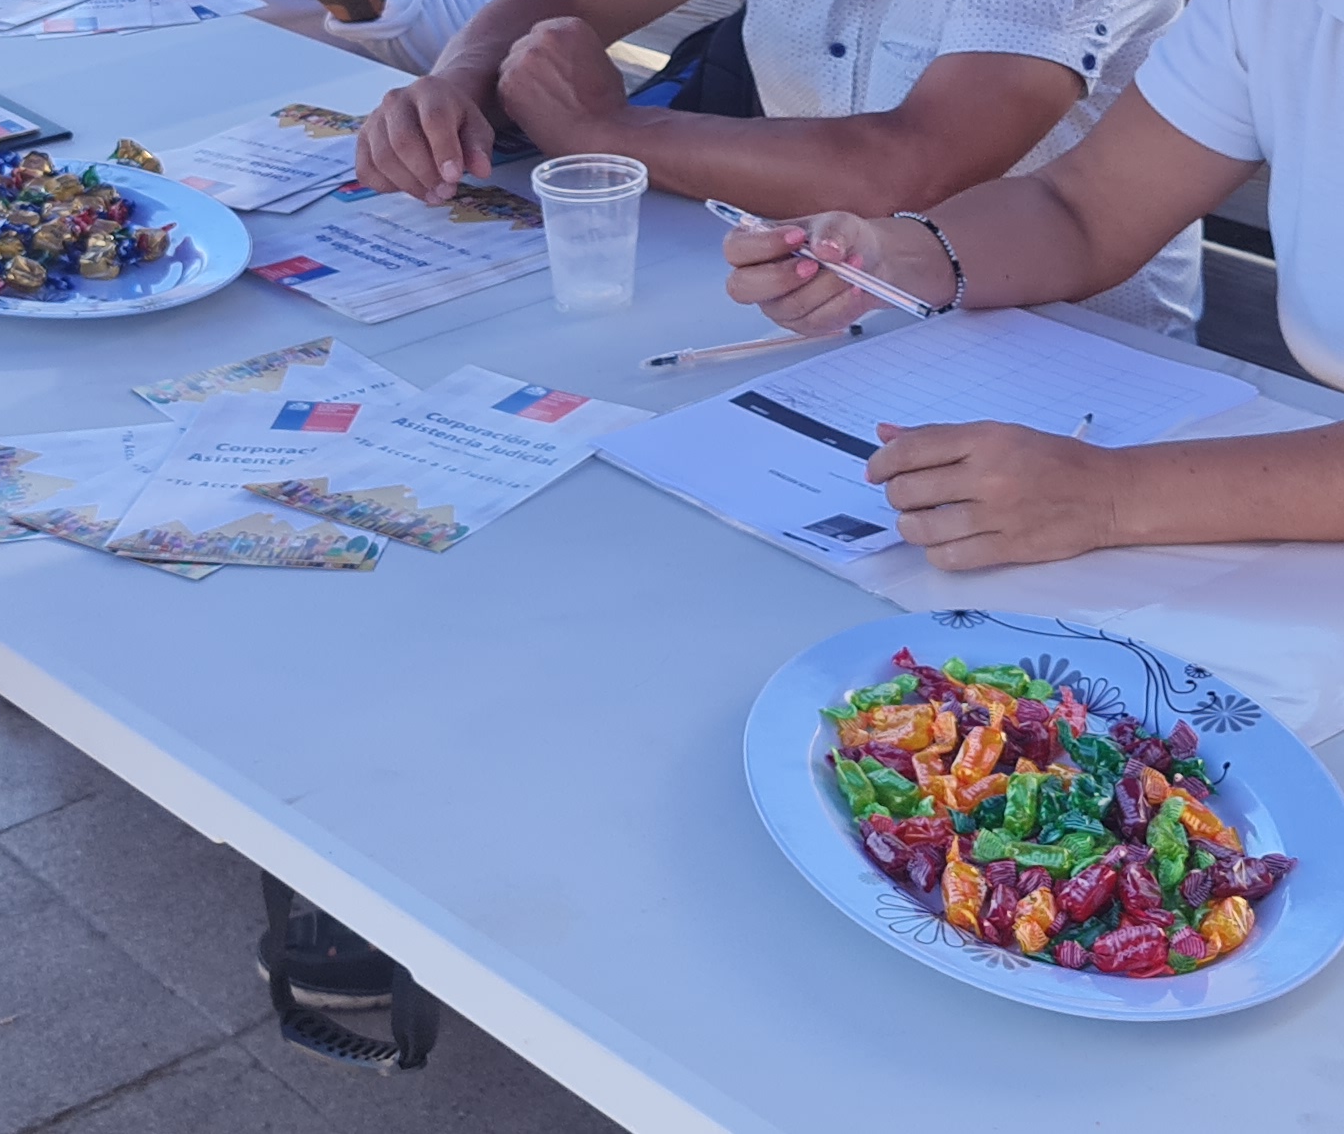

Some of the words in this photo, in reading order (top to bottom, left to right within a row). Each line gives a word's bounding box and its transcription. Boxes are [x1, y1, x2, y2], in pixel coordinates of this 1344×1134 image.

[391, 416, 483, 448] Asistencia
[484, 443, 559, 466] Judicial
[425, 410, 531, 447] Corporación
[536, 441, 557, 452] de
[377, 444, 427, 464] Acceso
[442, 463, 459, 472] la
